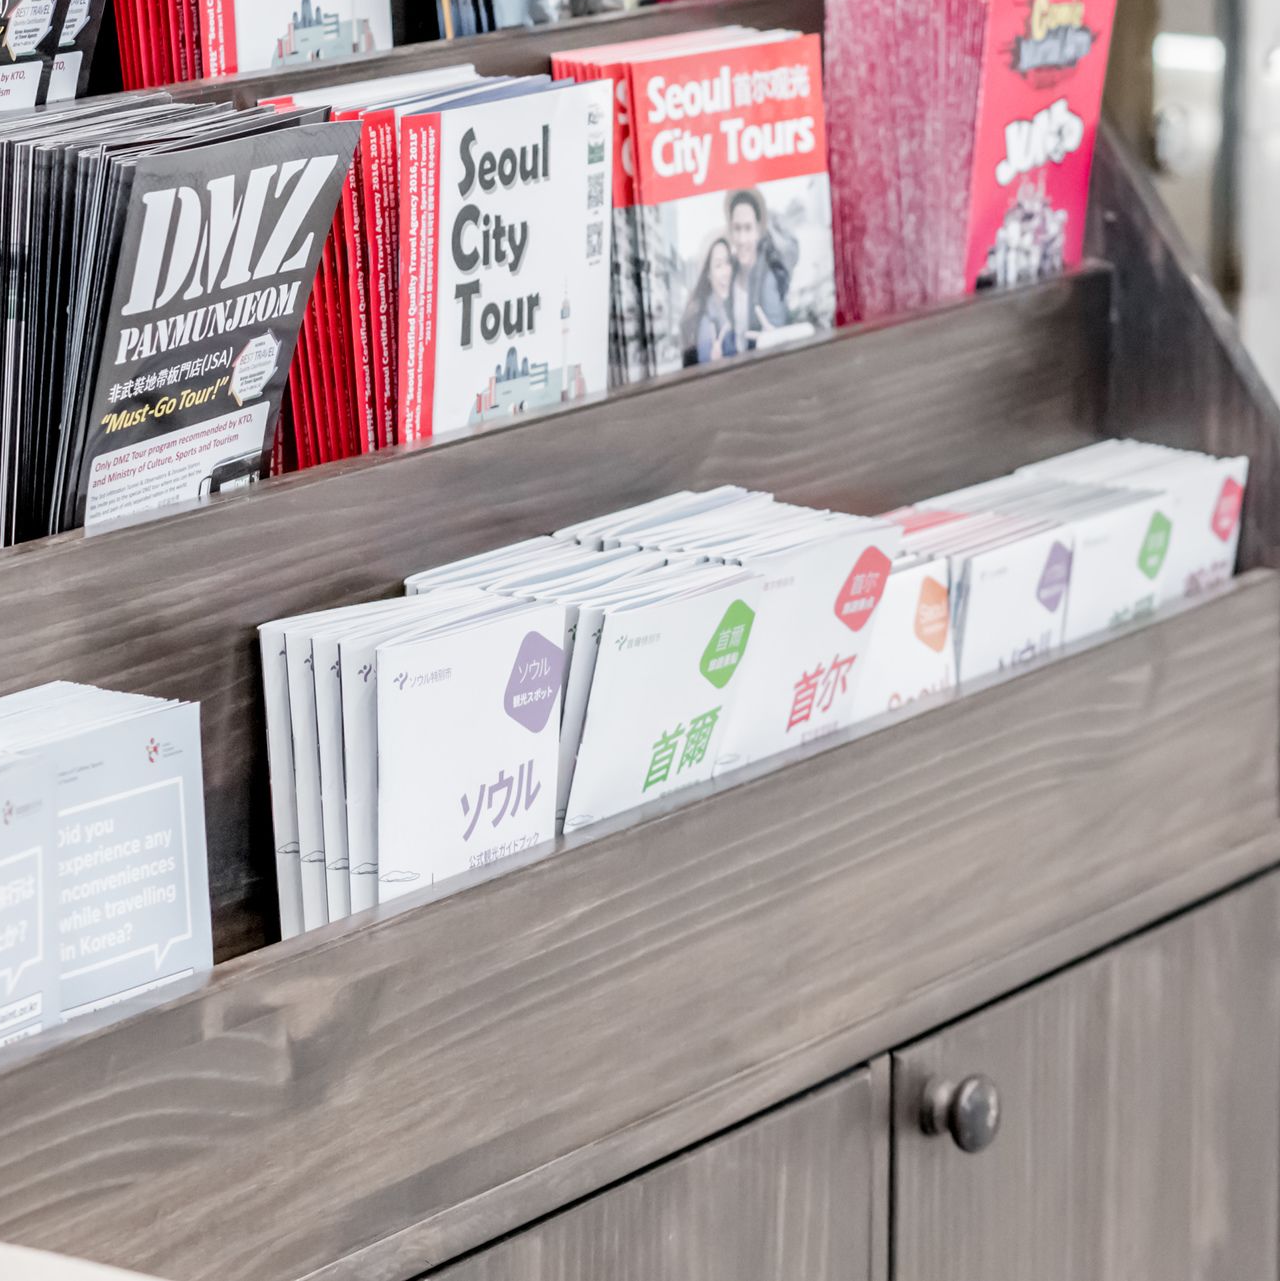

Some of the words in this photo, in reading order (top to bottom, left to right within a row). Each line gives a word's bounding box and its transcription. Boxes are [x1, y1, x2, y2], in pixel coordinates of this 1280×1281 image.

[0, 73, 9, 83] by
[10, 70, 25, 80] KTO,
[647, 65, 731, 124] Seoul
[458, 124, 550, 197] Seoul
[651, 128, 712, 186] City
[720, 116, 815, 164] Tours
[371, 159, 381, 190] 2016,
[409, 162, 419, 193] 2016,
[351, 191, 361, 230] Agency
[373, 192, 383, 233] Agency
[409, 194, 420, 235] Agency
[122, 154, 338, 316] DMZ
[355, 233, 363, 269] Travel
[375, 235, 384, 270] Travel
[408, 236, 418, 273] Travel
[451, 204, 527, 273] City
[357, 271, 366, 312] Quality
[377, 273, 387, 313] Quality
[407, 275, 418, 317] Quality
[455, 279, 539, 347] Tour
[115, 280, 301, 364] PANMUNJEOM
[360, 314, 369, 363] Certified
[380, 315, 389, 364] Certified
[407, 318, 416, 366] Certified
[92, 477, 106, 489] and
[107, 465, 137, 486] Ministry
[138, 462, 146, 473] of
[147, 453, 174, 470] Culture,
[175, 445, 197, 461] Sports
[198, 441, 212, 453] and
[213, 432, 239, 448] Tourism
[94, 460, 111, 473] Only
[113, 456, 130, 468] DMZ
[132, 450, 147, 462] Tour
[148, 441, 178, 457] program
[179, 425, 228, 445] recommended
[228, 420, 237, 431] by
[519, 657, 551, 684] ソウル
[786, 654, 858, 733] 首尔
[460, 759, 542, 842] ソウル
[84, 818, 115, 843] you
[144, 828, 173, 850] any
[61, 856, 176, 904] nconveniences
[59, 905, 102, 934] while
[104, 883, 177, 919] travelling
[60, 942, 76, 962] in
[80, 922, 133, 957] Korea?
